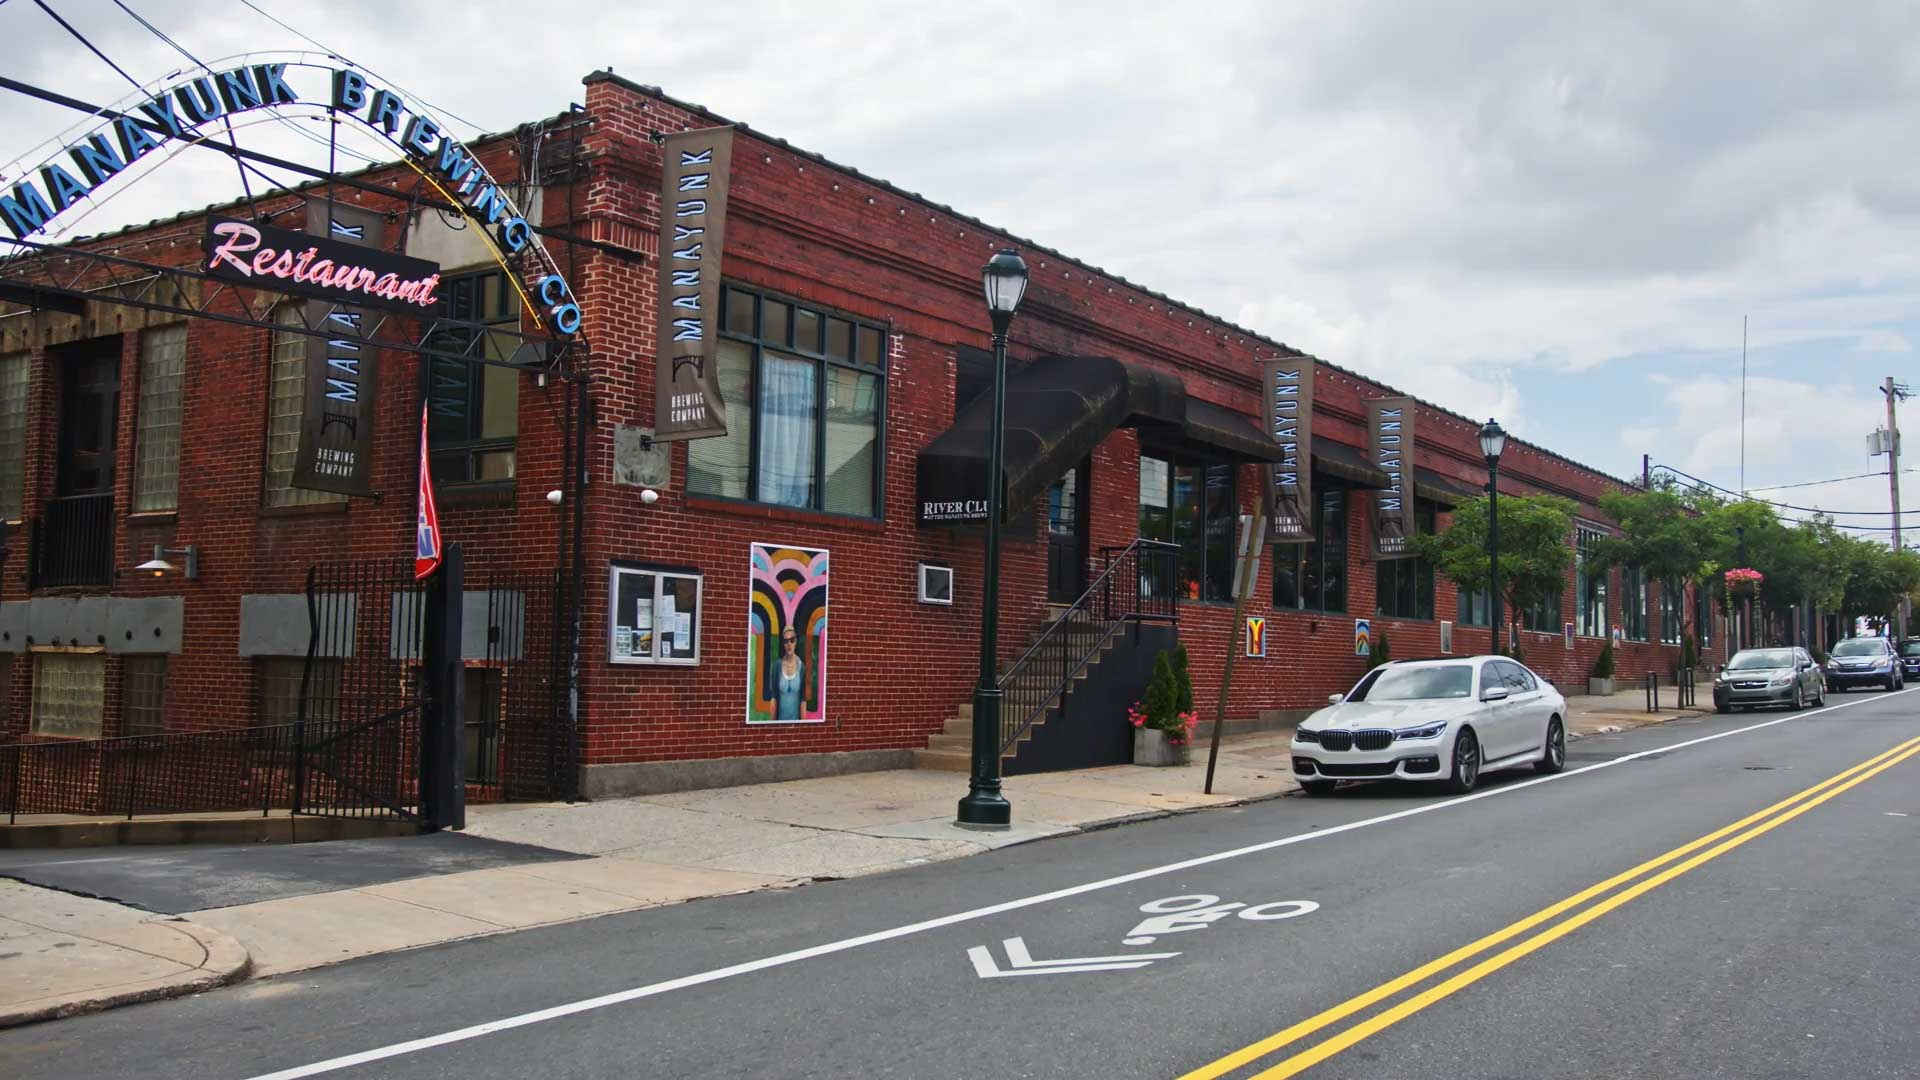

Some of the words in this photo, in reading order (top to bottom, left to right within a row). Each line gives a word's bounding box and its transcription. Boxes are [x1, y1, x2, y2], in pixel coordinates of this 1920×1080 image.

[1, 63, 299, 240] MANAYUNK
[333, 69, 530, 253] BREWING
[534, 274, 581, 335] CO
[210, 222, 440, 306] Restaurant
[671, 148, 713, 343] MANAYUNK
[326, 220, 363, 402] MANAK
[671, 406, 705, 423] COMPANY
[314, 461, 353, 477] COMPANY
[317, 447, 354, 464] BREWING
[923, 501, 963, 515] RIVER
